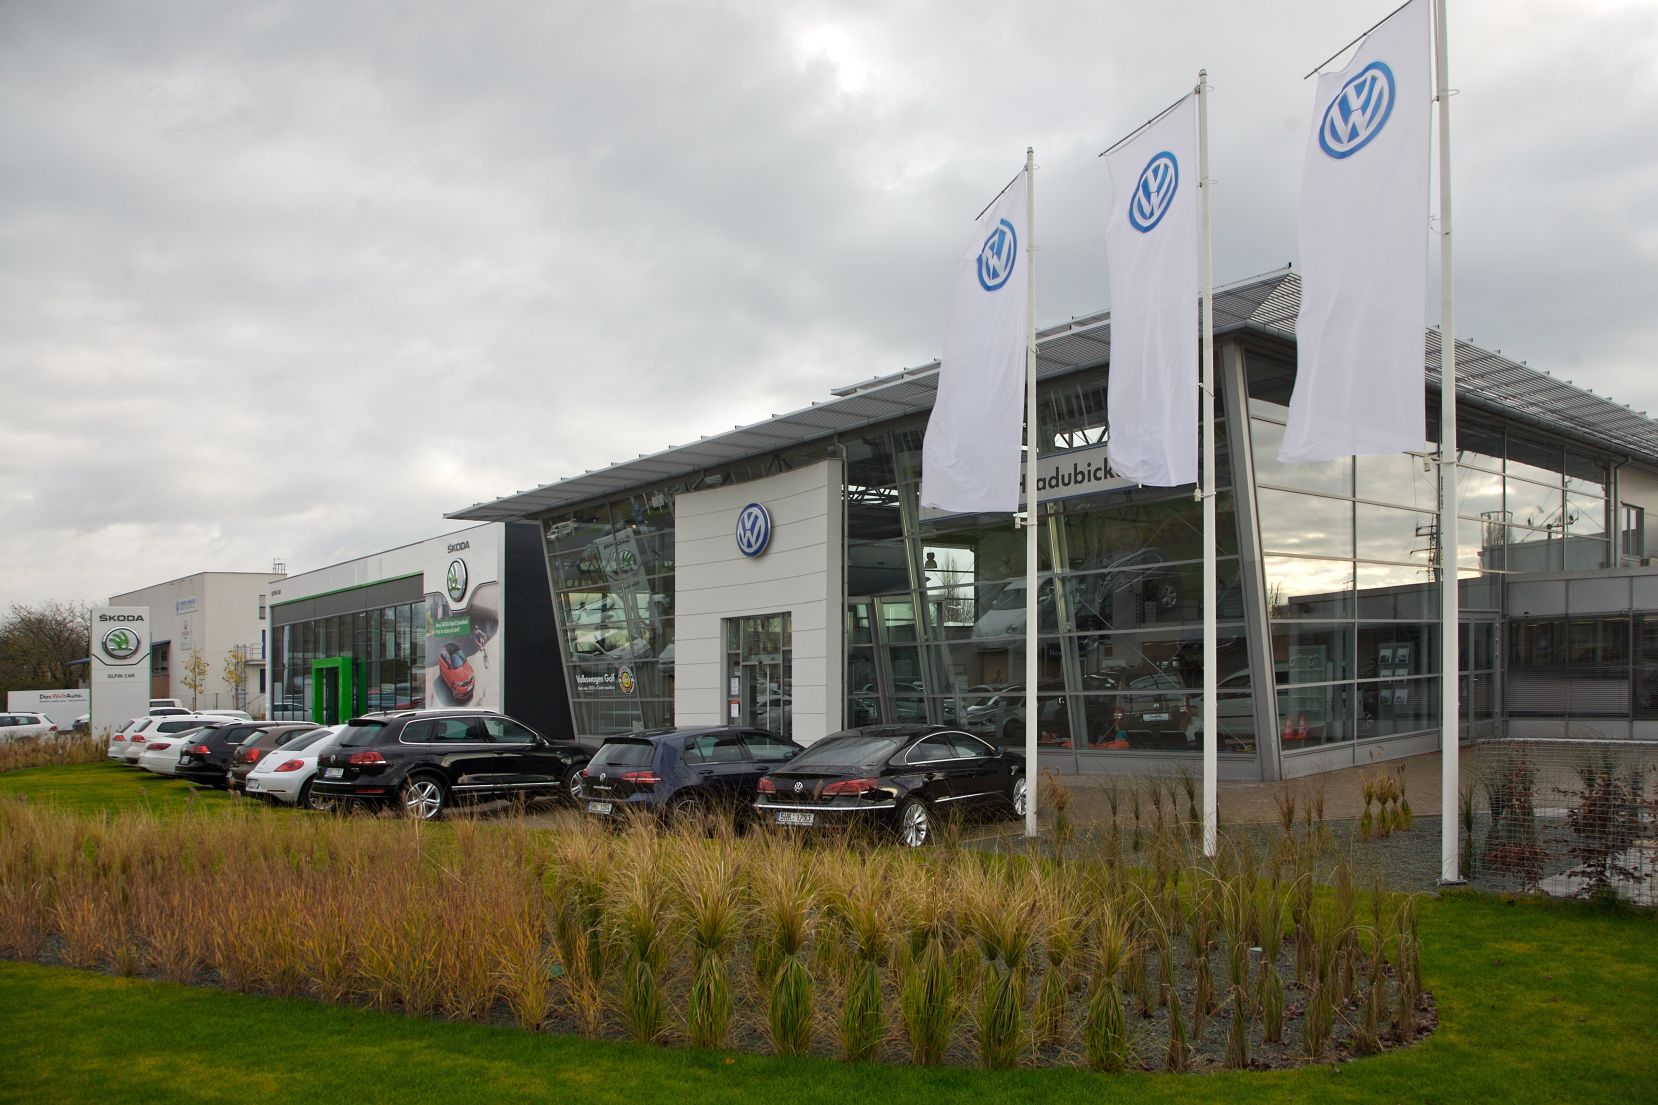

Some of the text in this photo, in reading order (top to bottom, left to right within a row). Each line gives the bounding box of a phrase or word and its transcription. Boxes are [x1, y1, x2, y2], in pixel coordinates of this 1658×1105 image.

[1020, 458, 1121, 494] adubick
[447, 540, 470, 553] ŠKODA
[576, 673, 615, 684] Volkswagen Golf
